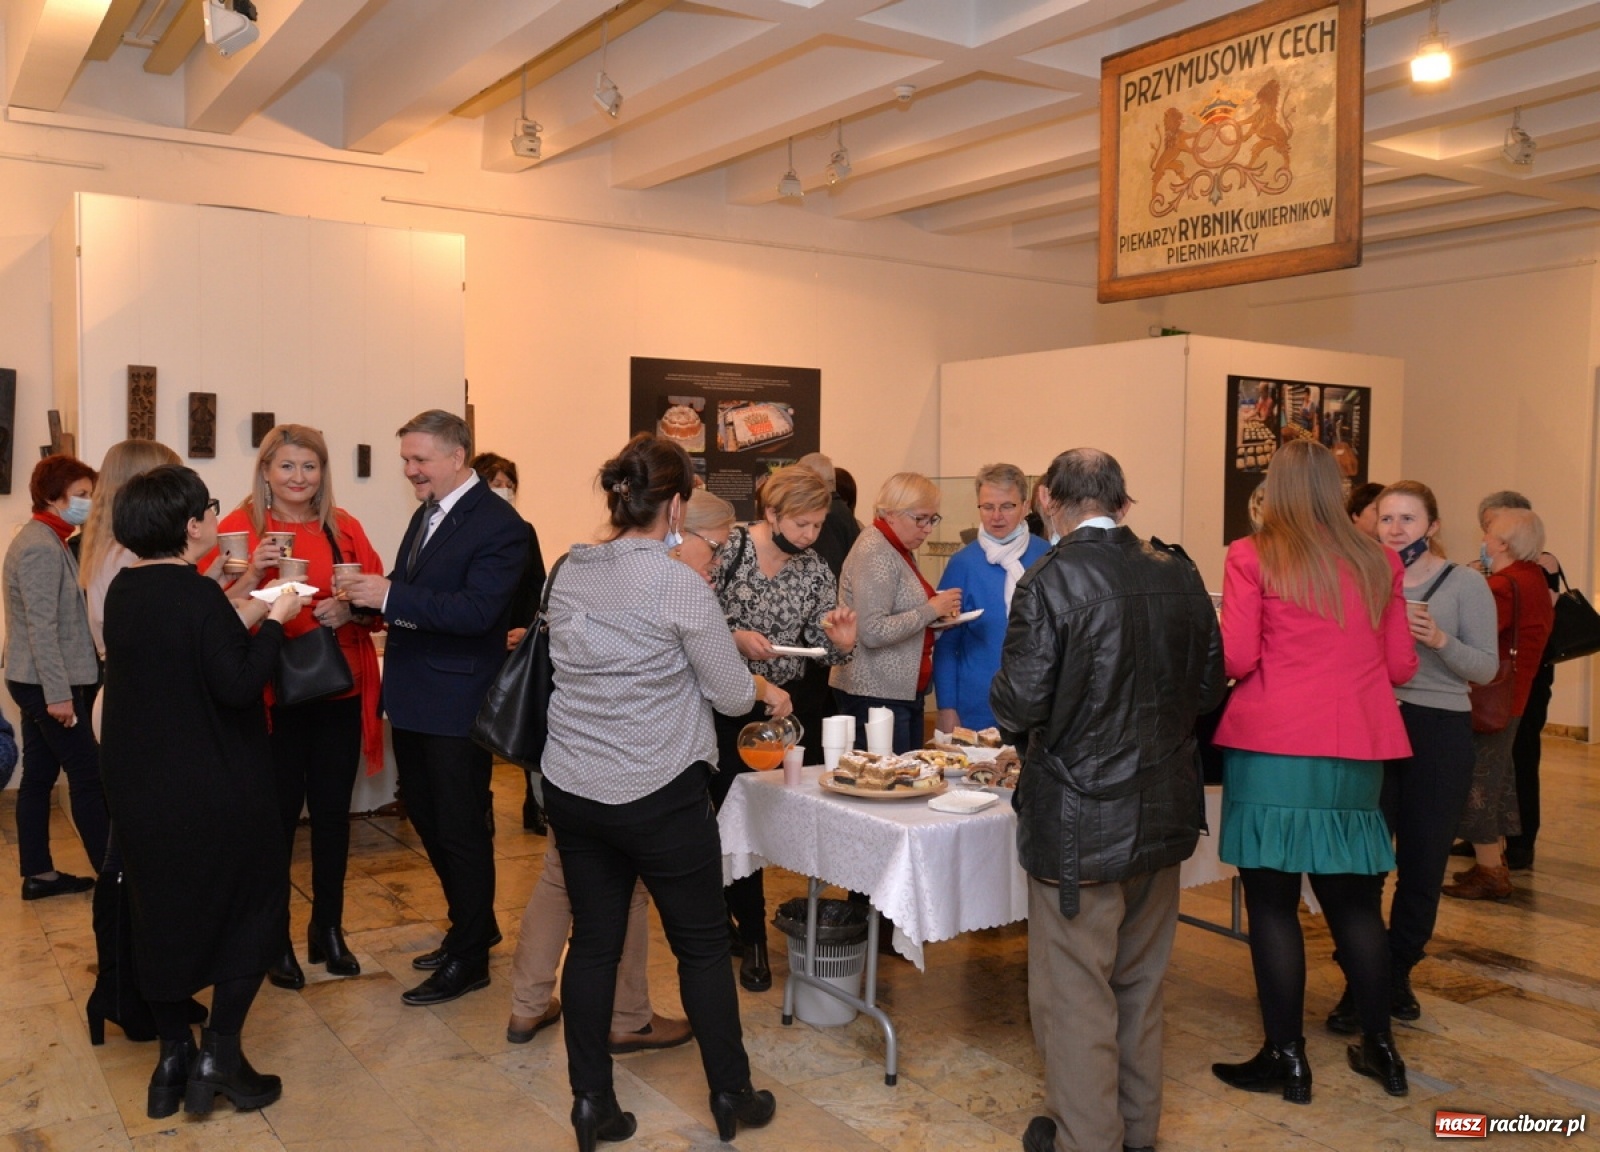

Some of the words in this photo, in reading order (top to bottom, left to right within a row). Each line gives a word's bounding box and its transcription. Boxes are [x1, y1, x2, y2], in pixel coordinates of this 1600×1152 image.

[1124, 32, 1274, 112] PRZYMUSOWY
[1279, 19, 1337, 60] CECH
[1119, 225, 1177, 254] PIEKARZY
[1178, 208, 1245, 243] RYBNIK
[1167, 233, 1259, 265] PIERNIKARZY
